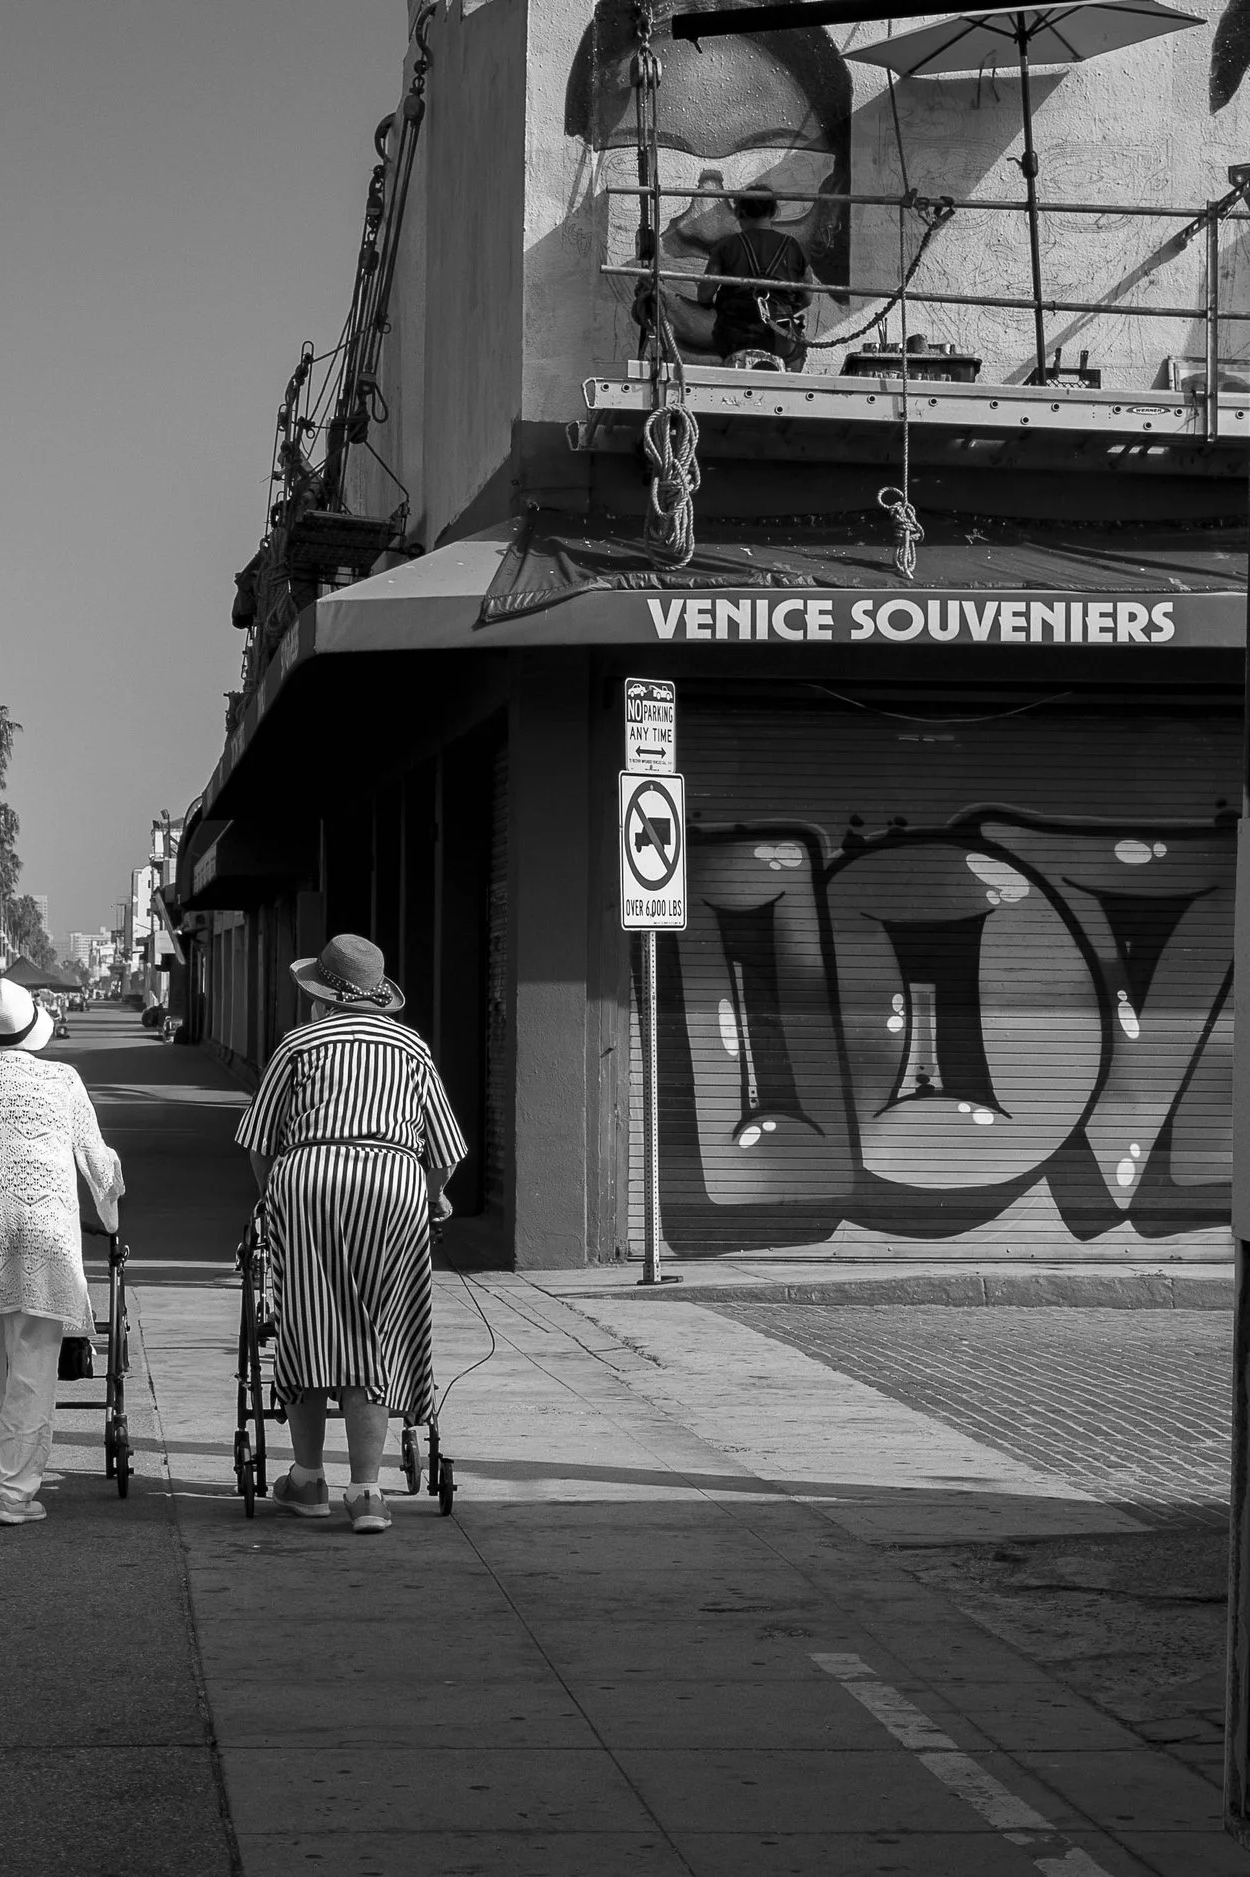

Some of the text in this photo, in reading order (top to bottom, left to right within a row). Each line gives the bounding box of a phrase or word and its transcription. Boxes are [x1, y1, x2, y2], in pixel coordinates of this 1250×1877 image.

[647, 598, 1174, 643] VENICE SOUVENIERS
[627, 699, 673, 723] NO PARKING
[629, 726, 673, 743] ANY TIME
[626, 899, 644, 917] OVER
[668, 899, 682, 917] LBS
